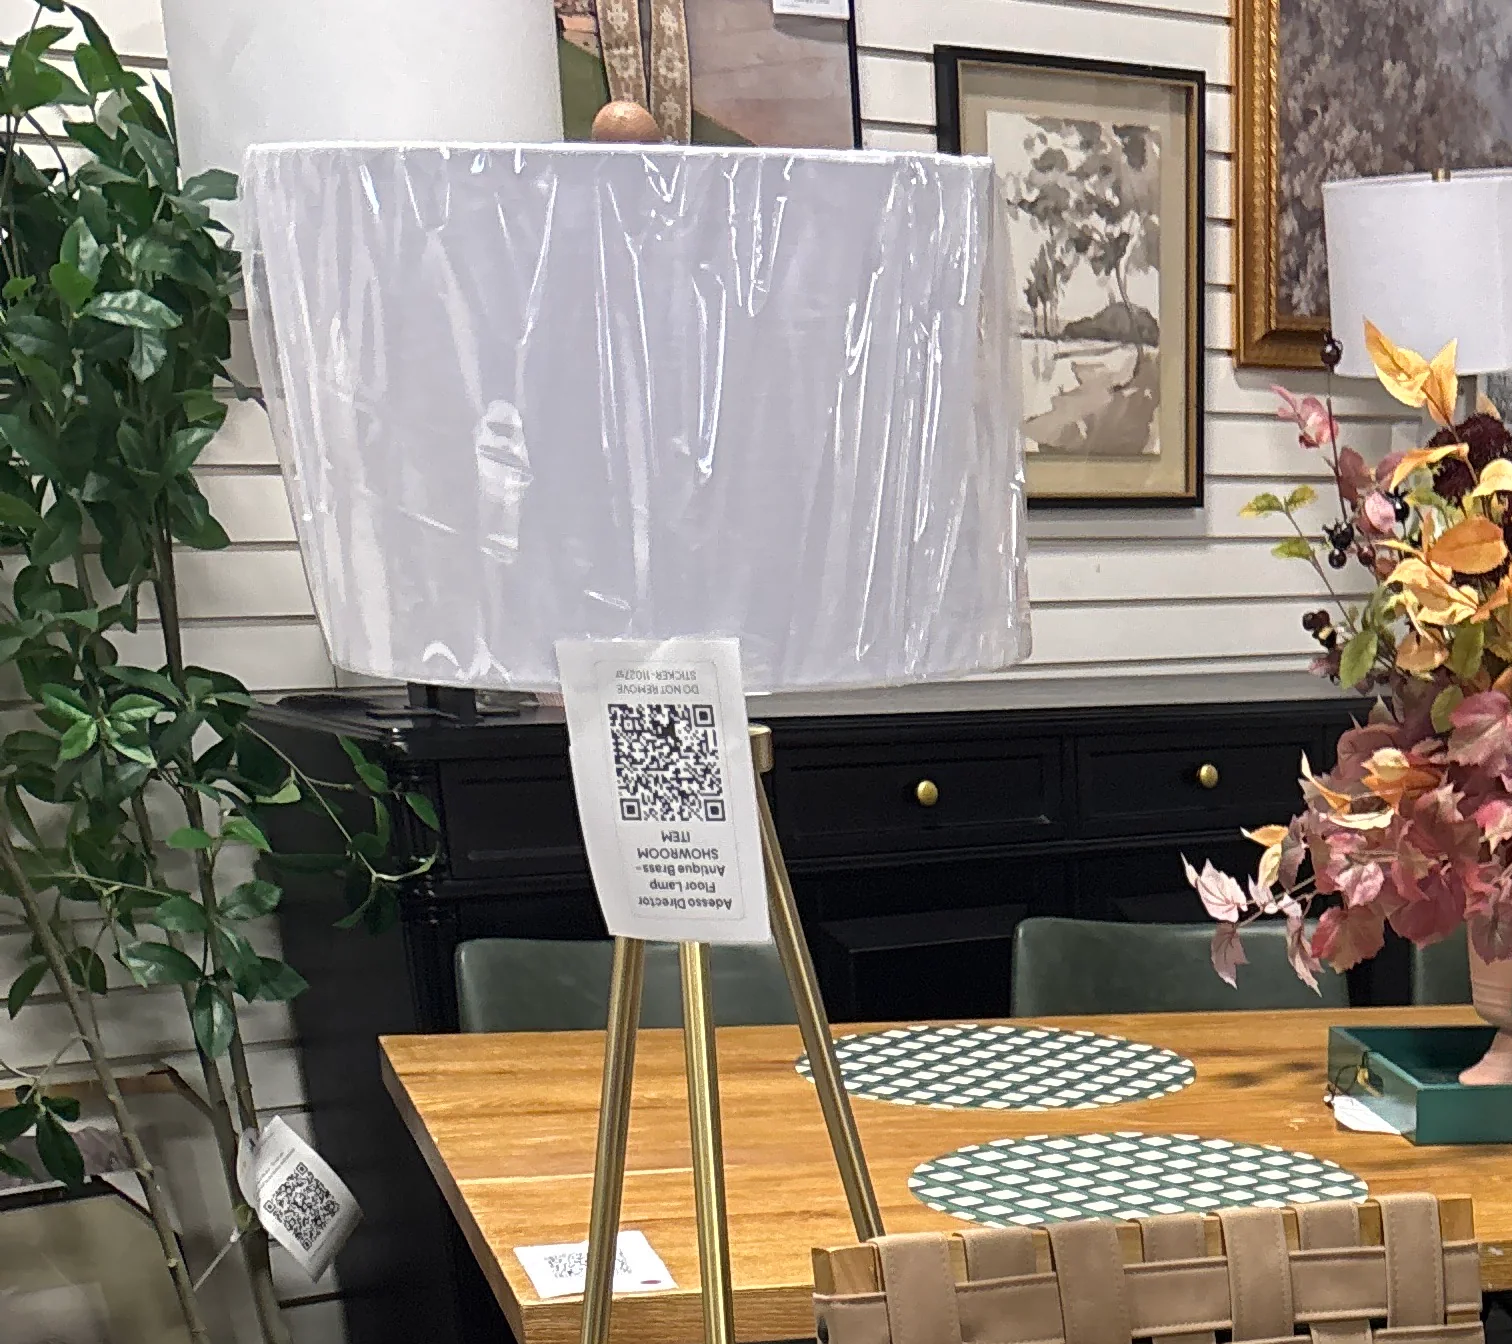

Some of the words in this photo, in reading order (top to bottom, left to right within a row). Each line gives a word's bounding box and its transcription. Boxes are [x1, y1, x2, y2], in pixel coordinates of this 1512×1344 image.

[617, 684, 659, 695] REMOVE
[661, 684, 681, 695] NOT
[683, 684, 699, 695] DO
[661, 830, 691, 843] ITEM
[637, 848, 719, 860] SHOWROOM
[677, 862, 726, 877] Antique
[649, 880, 682, 892] Lamp
[685, 881, 716, 893] Floor
[638, 896, 686, 909] Director
[688, 897, 732, 910] Adesso
